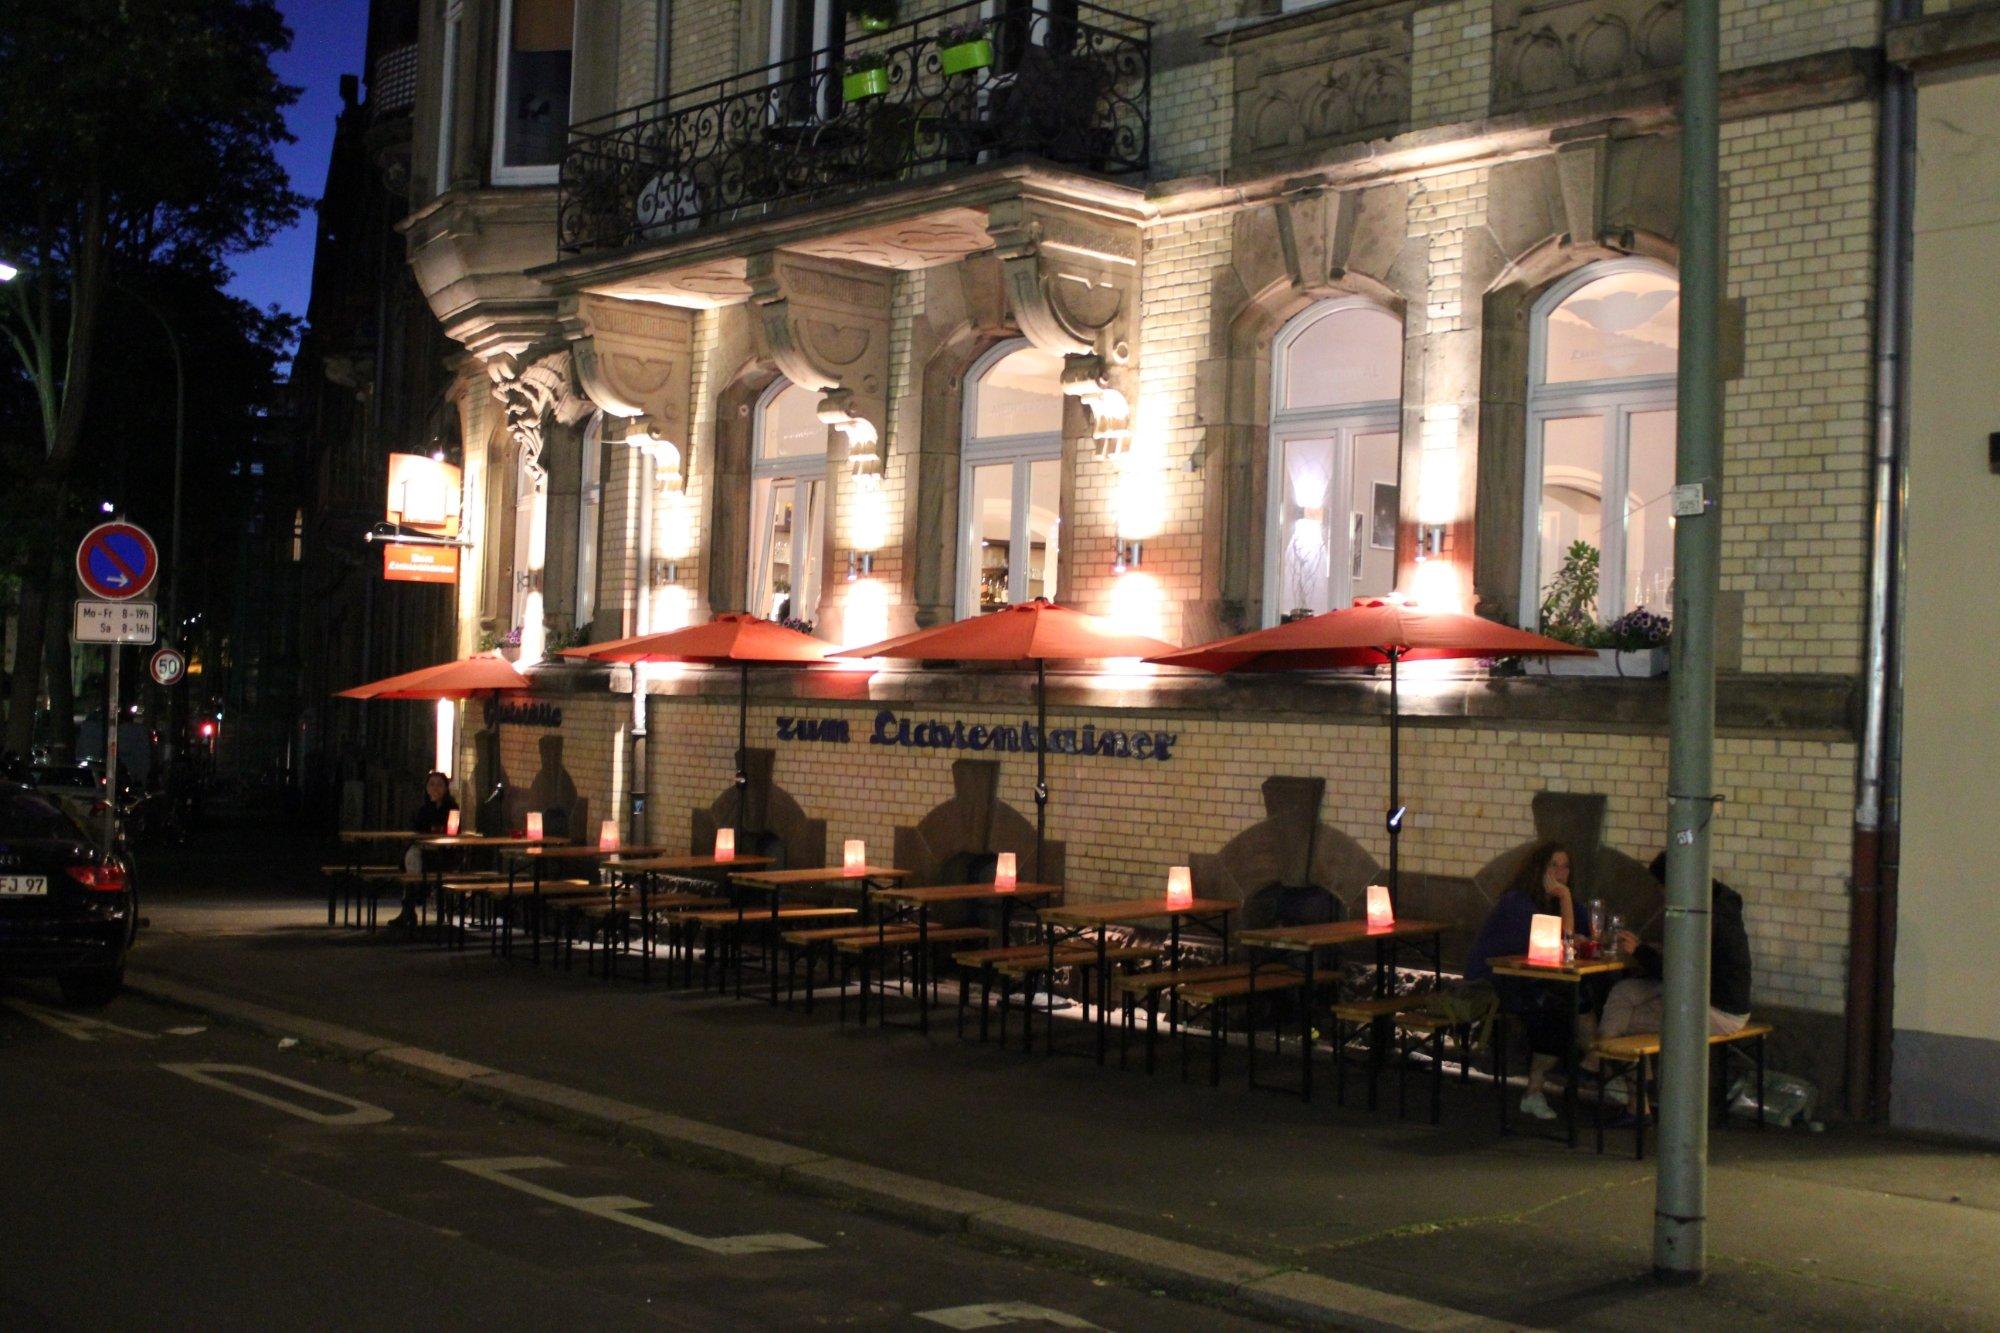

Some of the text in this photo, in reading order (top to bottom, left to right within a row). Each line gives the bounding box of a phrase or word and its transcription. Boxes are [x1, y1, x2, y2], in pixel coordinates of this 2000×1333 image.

[100, 623, 111, 633] Sa
[159, 660, 177, 675] 50
[776, 710, 1178, 761] zum Lichtenhainer
[25, 878, 44, 893] 97
